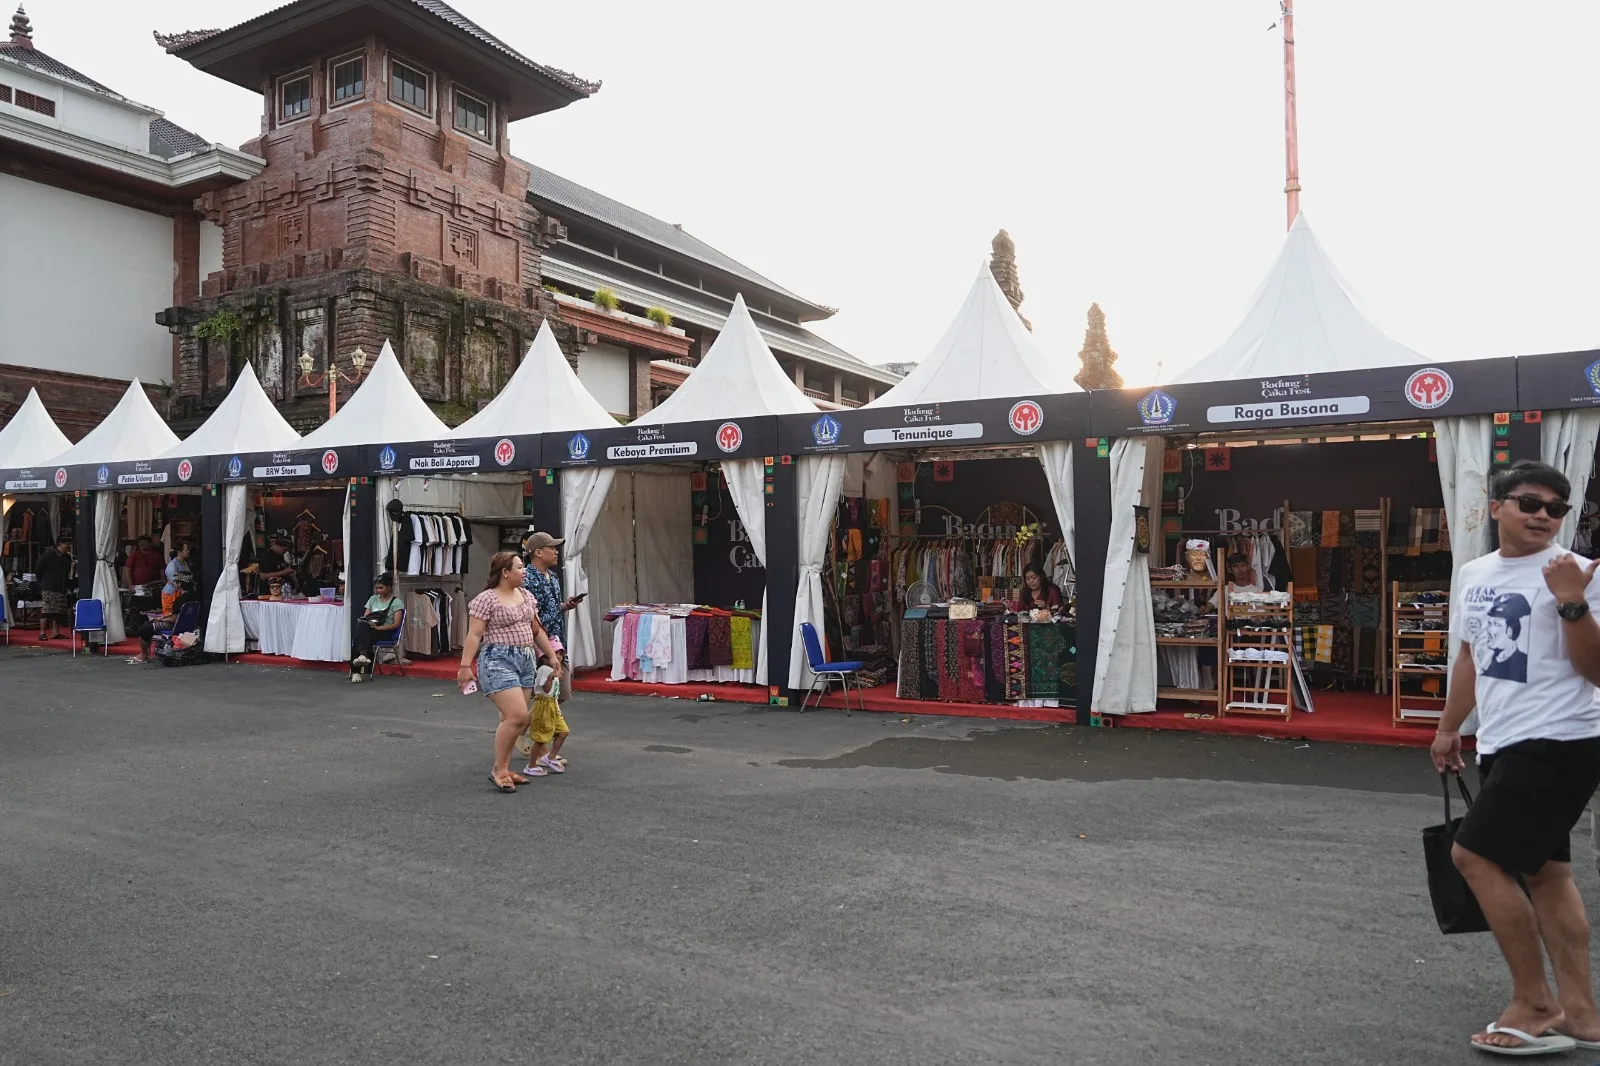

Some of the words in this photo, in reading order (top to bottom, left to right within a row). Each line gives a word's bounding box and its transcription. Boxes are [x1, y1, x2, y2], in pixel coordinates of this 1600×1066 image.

[1260, 379, 1300, 389] Badung
[1289, 387, 1312, 396] Fest
[1234, 406, 1274, 420] Raga
[1280, 403, 1339, 416] Busana
[892, 428, 953, 441] Tenunique
[613, 446, 646, 458] Kebaya
[649, 444, 690, 456] Premium
[414, 459, 429, 468] Nak
[431, 458, 445, 467] Bali
[446, 457, 475, 469] Apparel
[265, 467, 280, 476] BRW
[281, 467, 297, 475] Store
[121, 475, 135, 483] Patin
[135, 475, 152, 484] Udeng
